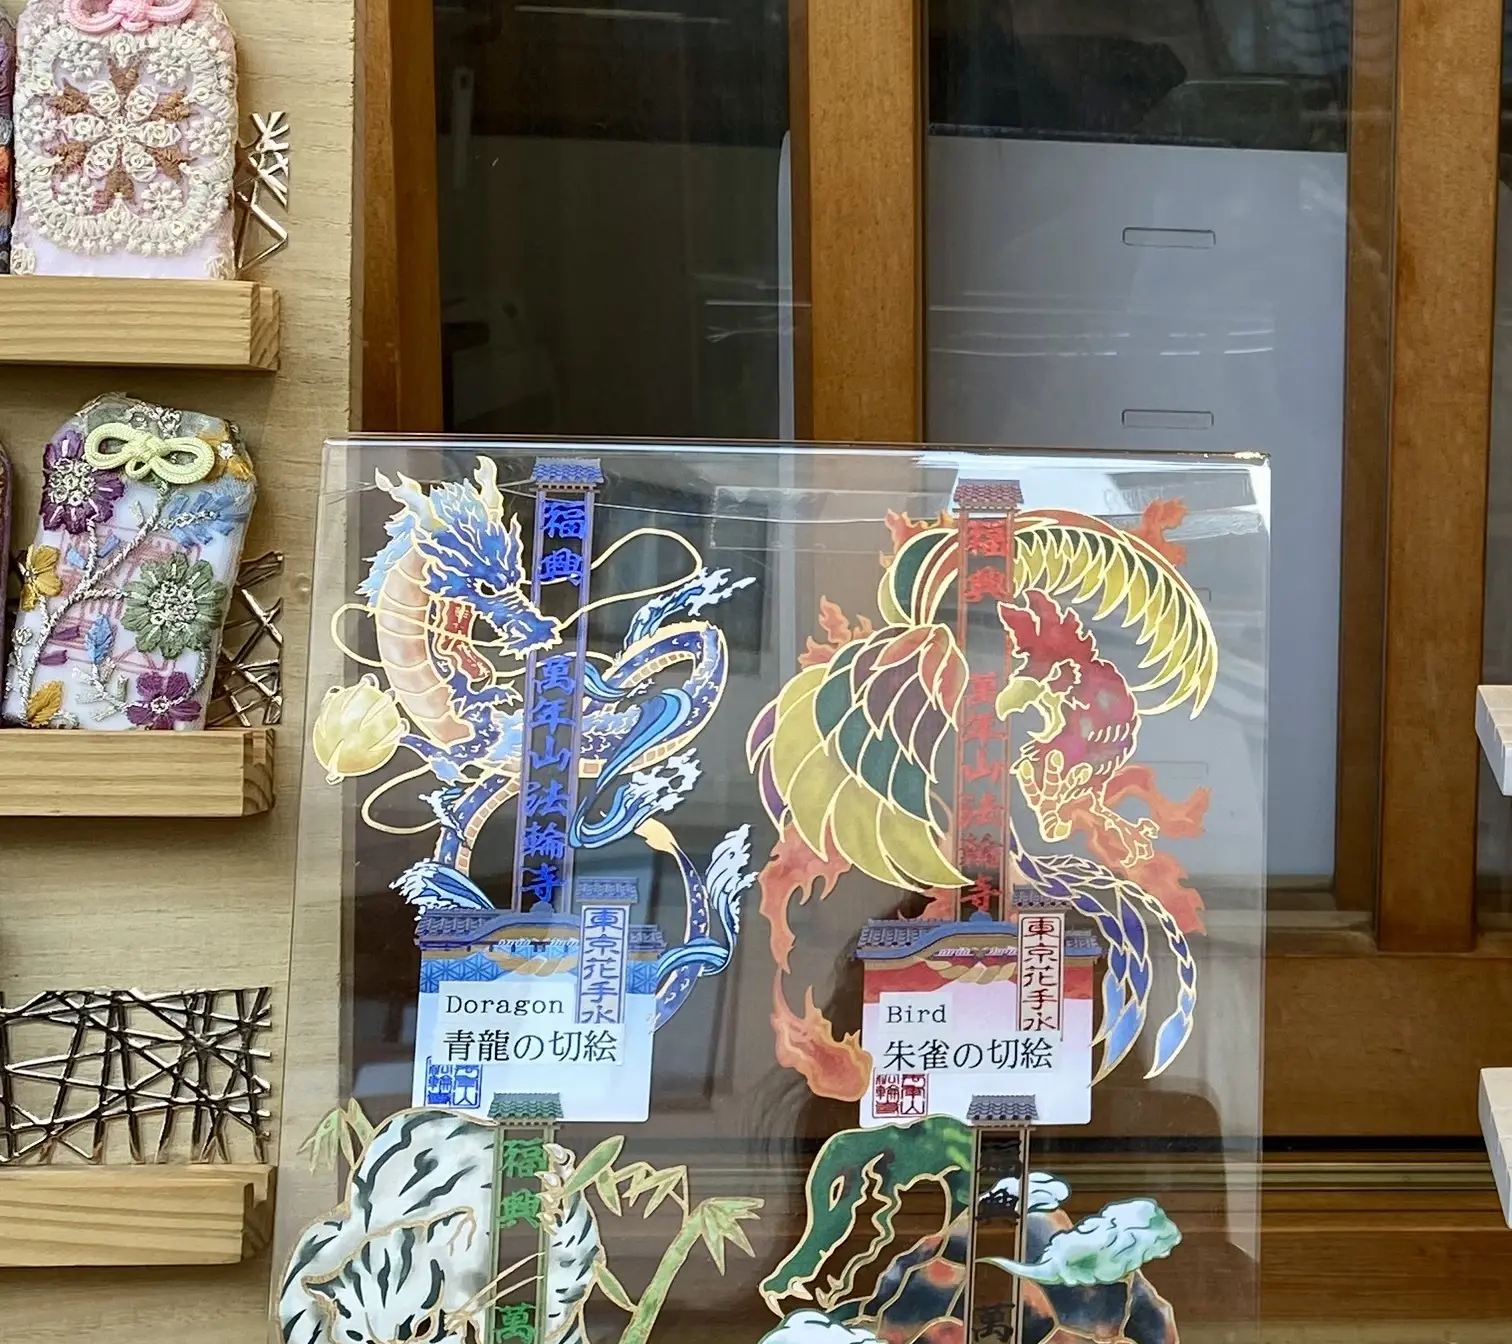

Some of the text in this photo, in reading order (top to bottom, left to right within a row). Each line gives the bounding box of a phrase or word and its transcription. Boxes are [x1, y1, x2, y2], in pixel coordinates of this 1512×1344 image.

[445, 995, 564, 1016] Doragon
[886, 1003, 947, 1024] Bird
[443, 1028, 618, 1063] 青龍の切絵
[883, 1037, 1053, 1071] 朱雀の切絵
